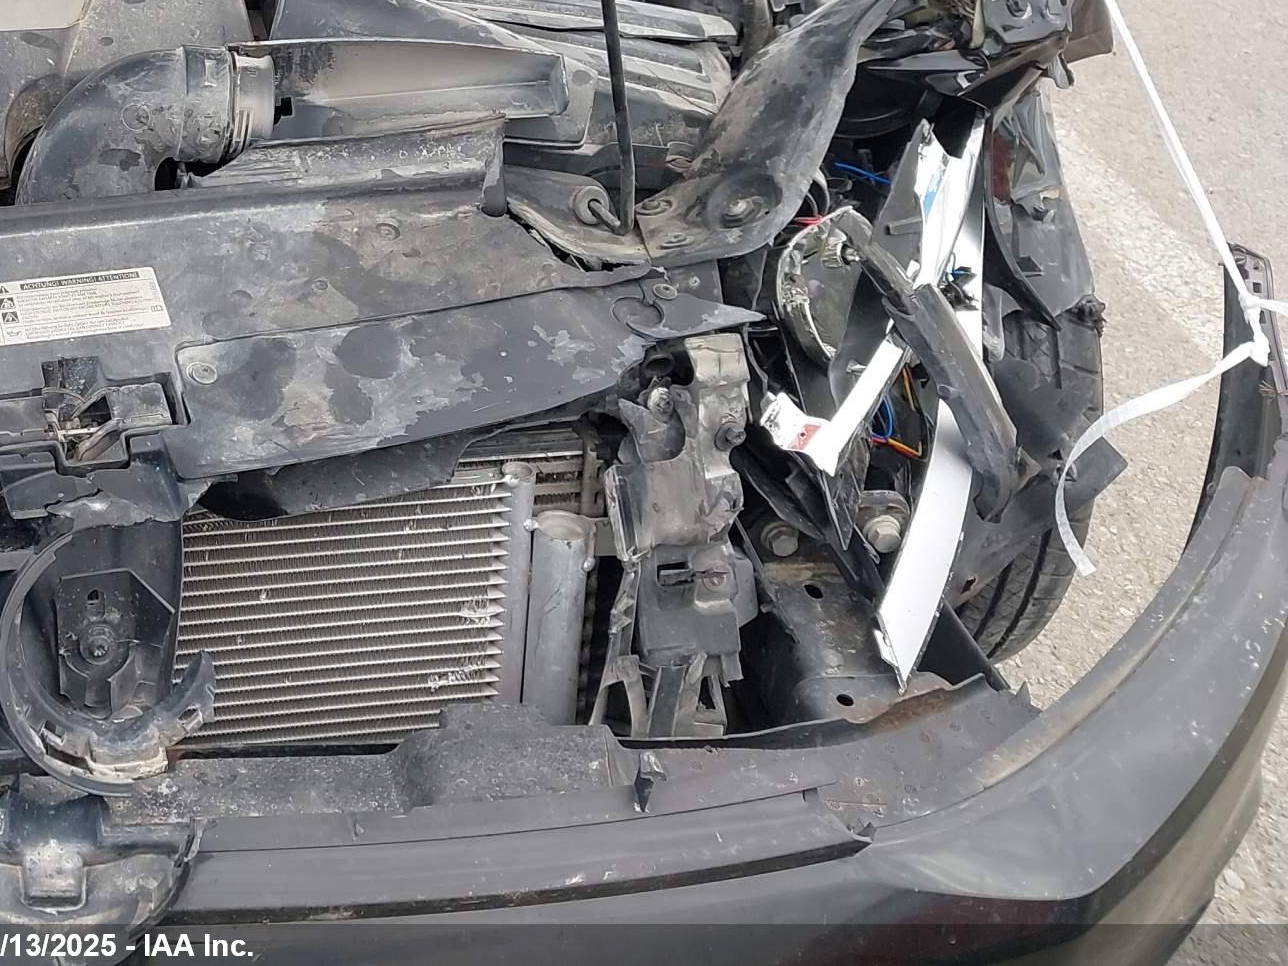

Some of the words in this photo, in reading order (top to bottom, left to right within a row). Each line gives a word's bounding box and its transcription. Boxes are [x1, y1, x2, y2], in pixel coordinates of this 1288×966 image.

[22, 280, 60, 291] ACHTUNG!
[60, 276, 97, 287] WARNING!
[97, 271, 138, 283] ATTENTION!
